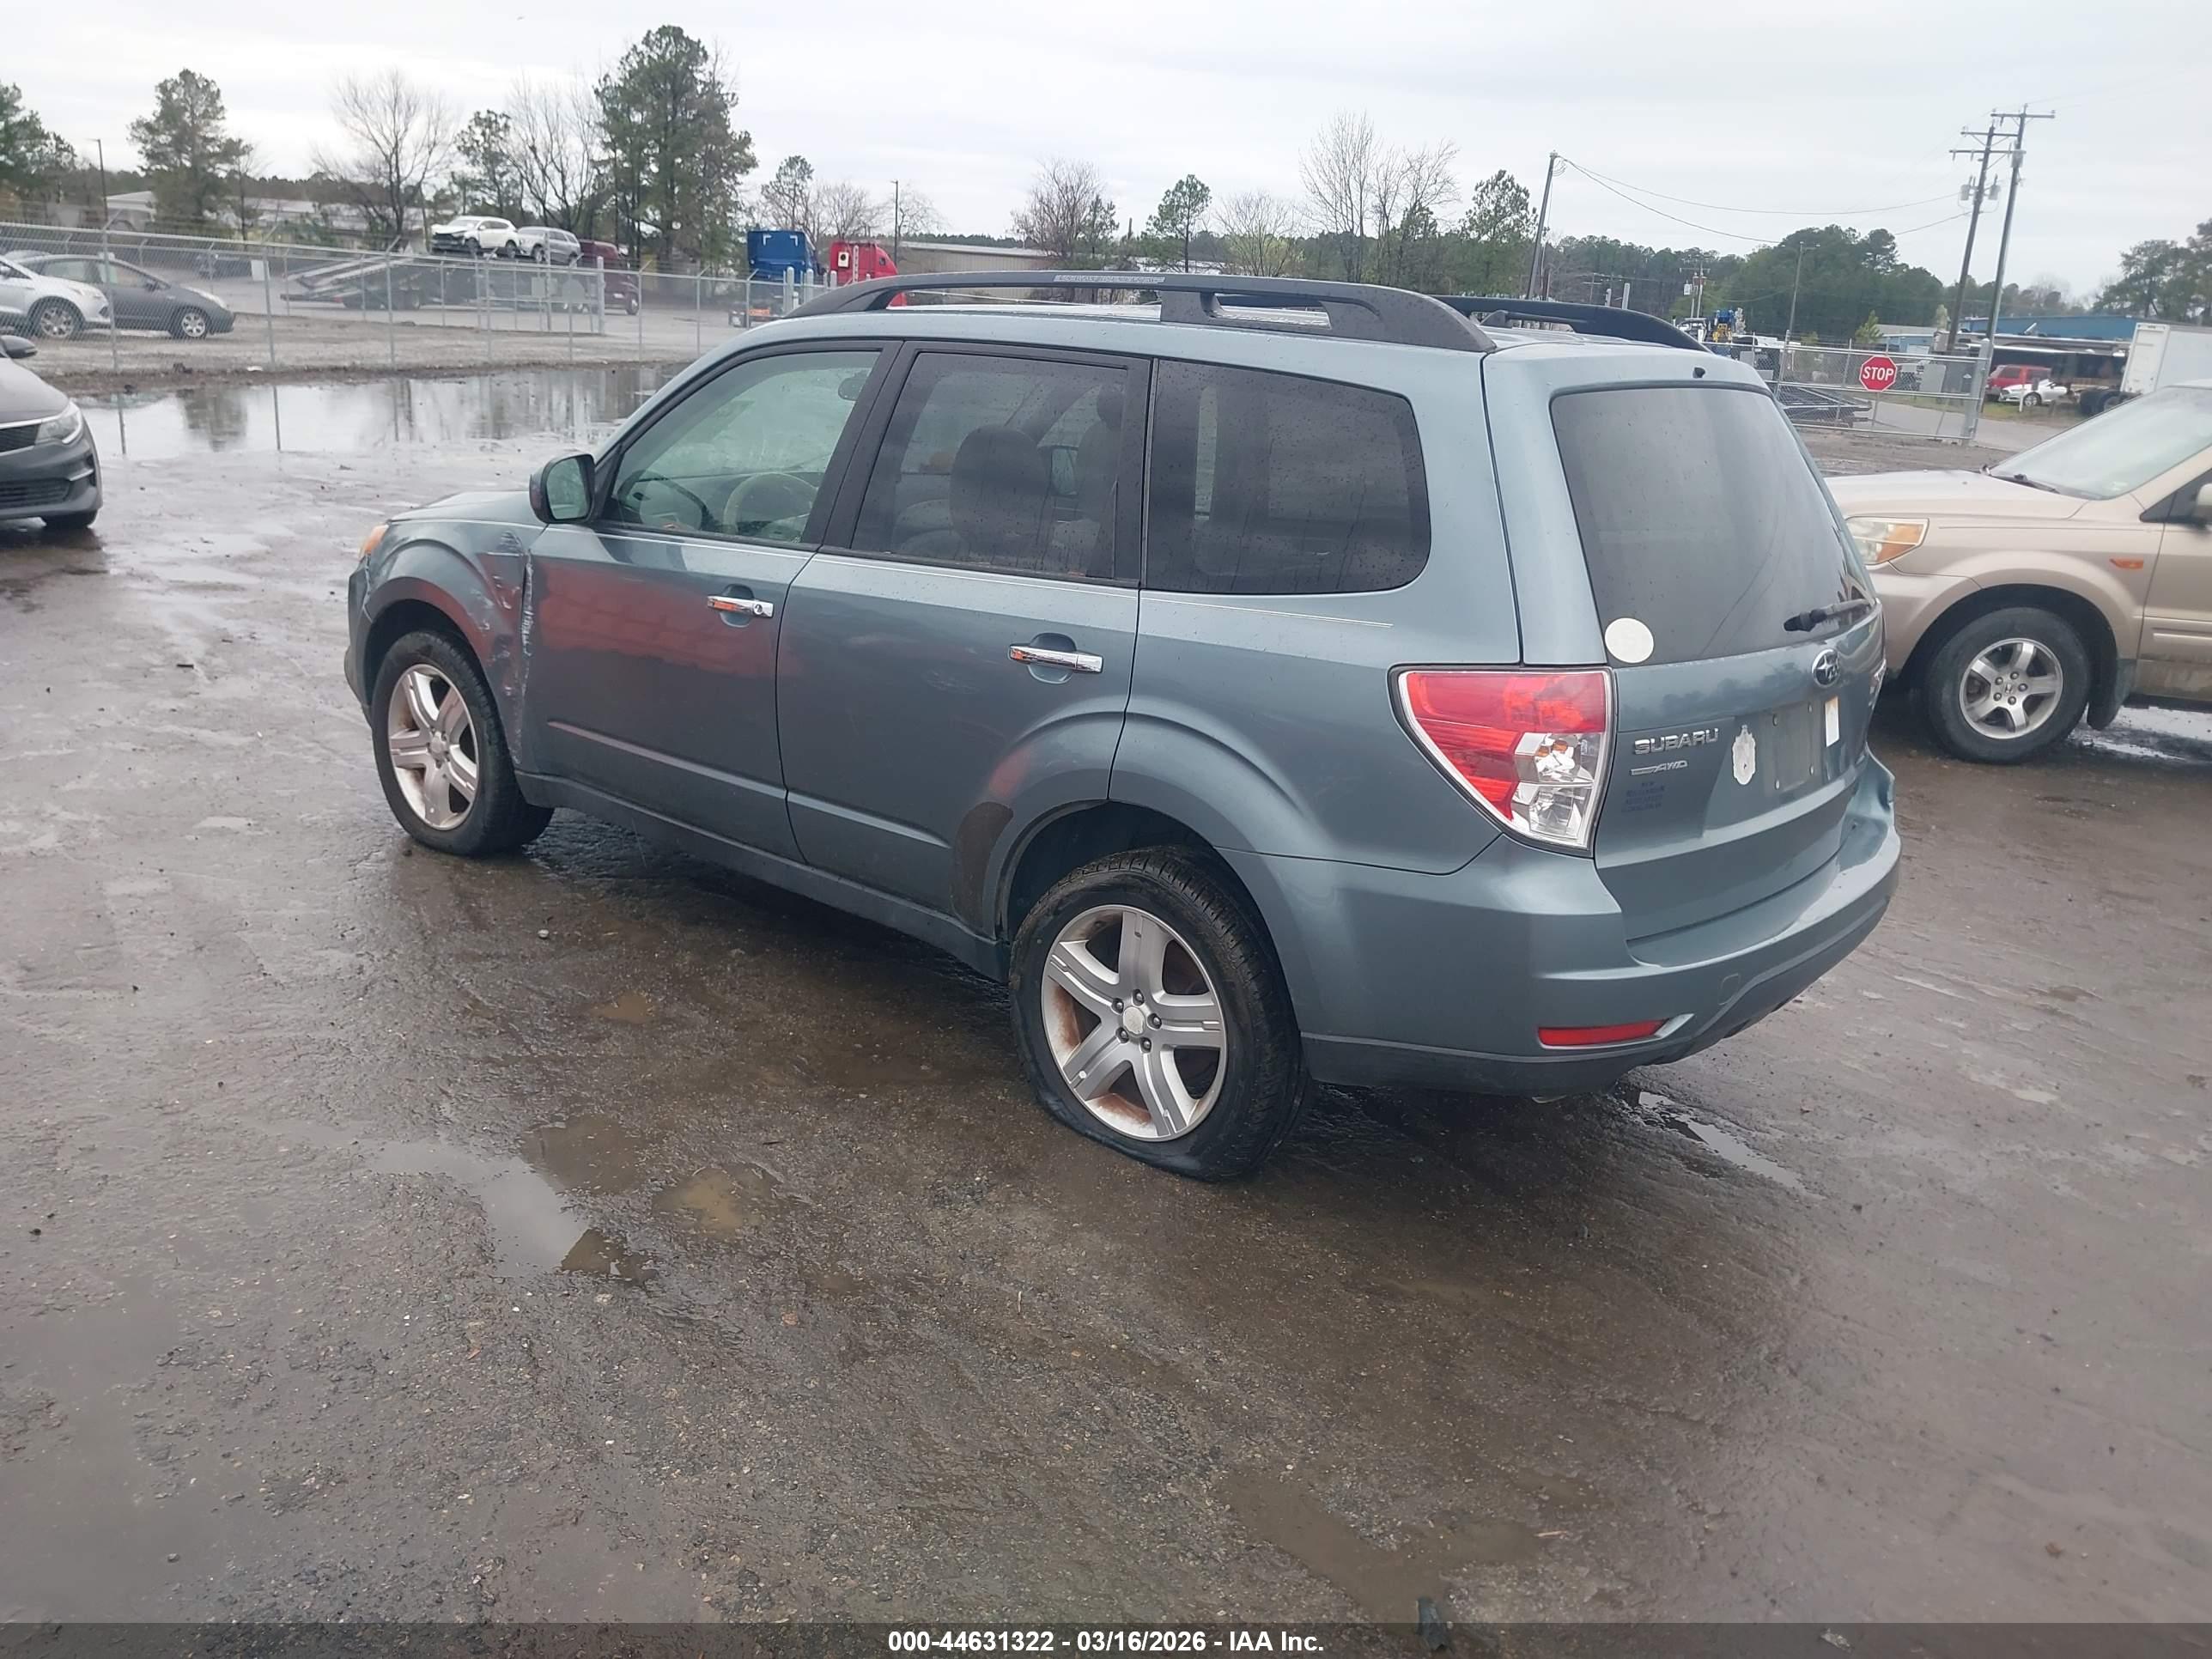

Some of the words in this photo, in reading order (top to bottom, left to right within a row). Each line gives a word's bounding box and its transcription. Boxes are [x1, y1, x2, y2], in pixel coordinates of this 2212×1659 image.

[1863, 366, 1893, 380] STOP
[1634, 728, 1718, 754] SUBARU
[1655, 760, 1688, 773] AWD
